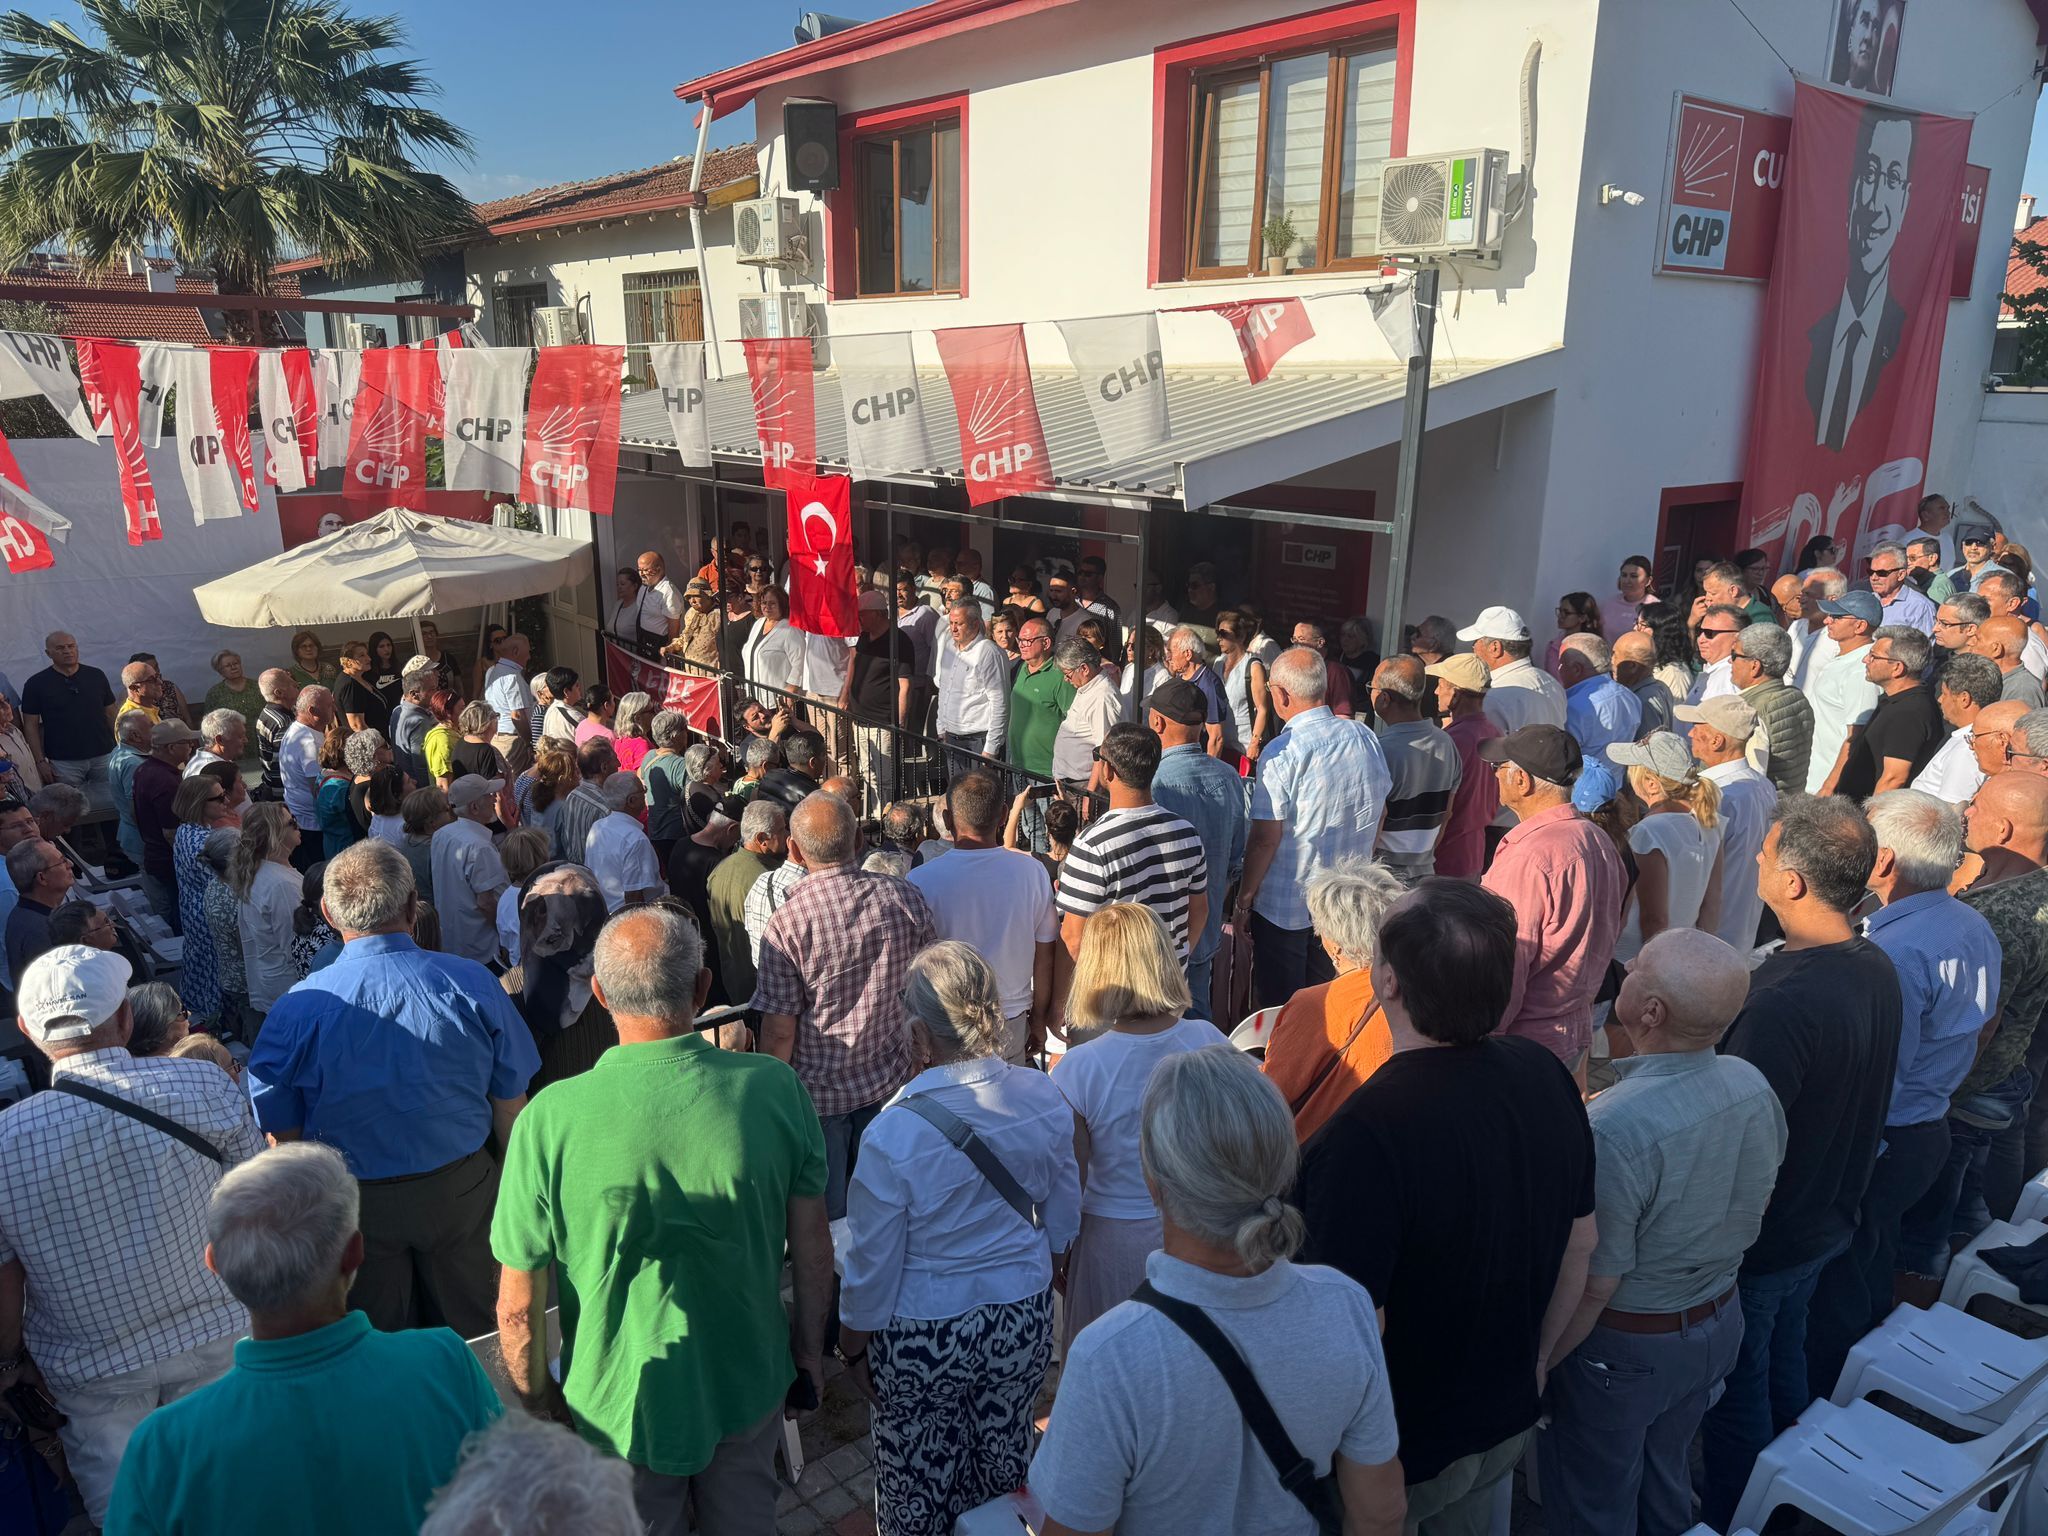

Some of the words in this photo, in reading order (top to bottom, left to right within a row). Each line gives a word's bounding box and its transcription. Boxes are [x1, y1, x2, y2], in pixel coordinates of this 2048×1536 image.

[1463, 181, 1473, 216] SIGMA
[1671, 213, 1725, 257] CHP
[1247, 303, 1285, 341] HP
[10, 333, 61, 373] CHP
[1100, 349, 1163, 402] CHP
[662, 388, 703, 413] HP
[851, 387, 916, 425] CHP
[272, 416, 297, 445] CH
[456, 418, 511, 443] CHP
[760, 440, 795, 468] HP
[970, 443, 1033, 482] CHP
[355, 459, 410, 489] CHP
[530, 460, 589, 490] CHP
[1304, 549, 1331, 564] CHP
